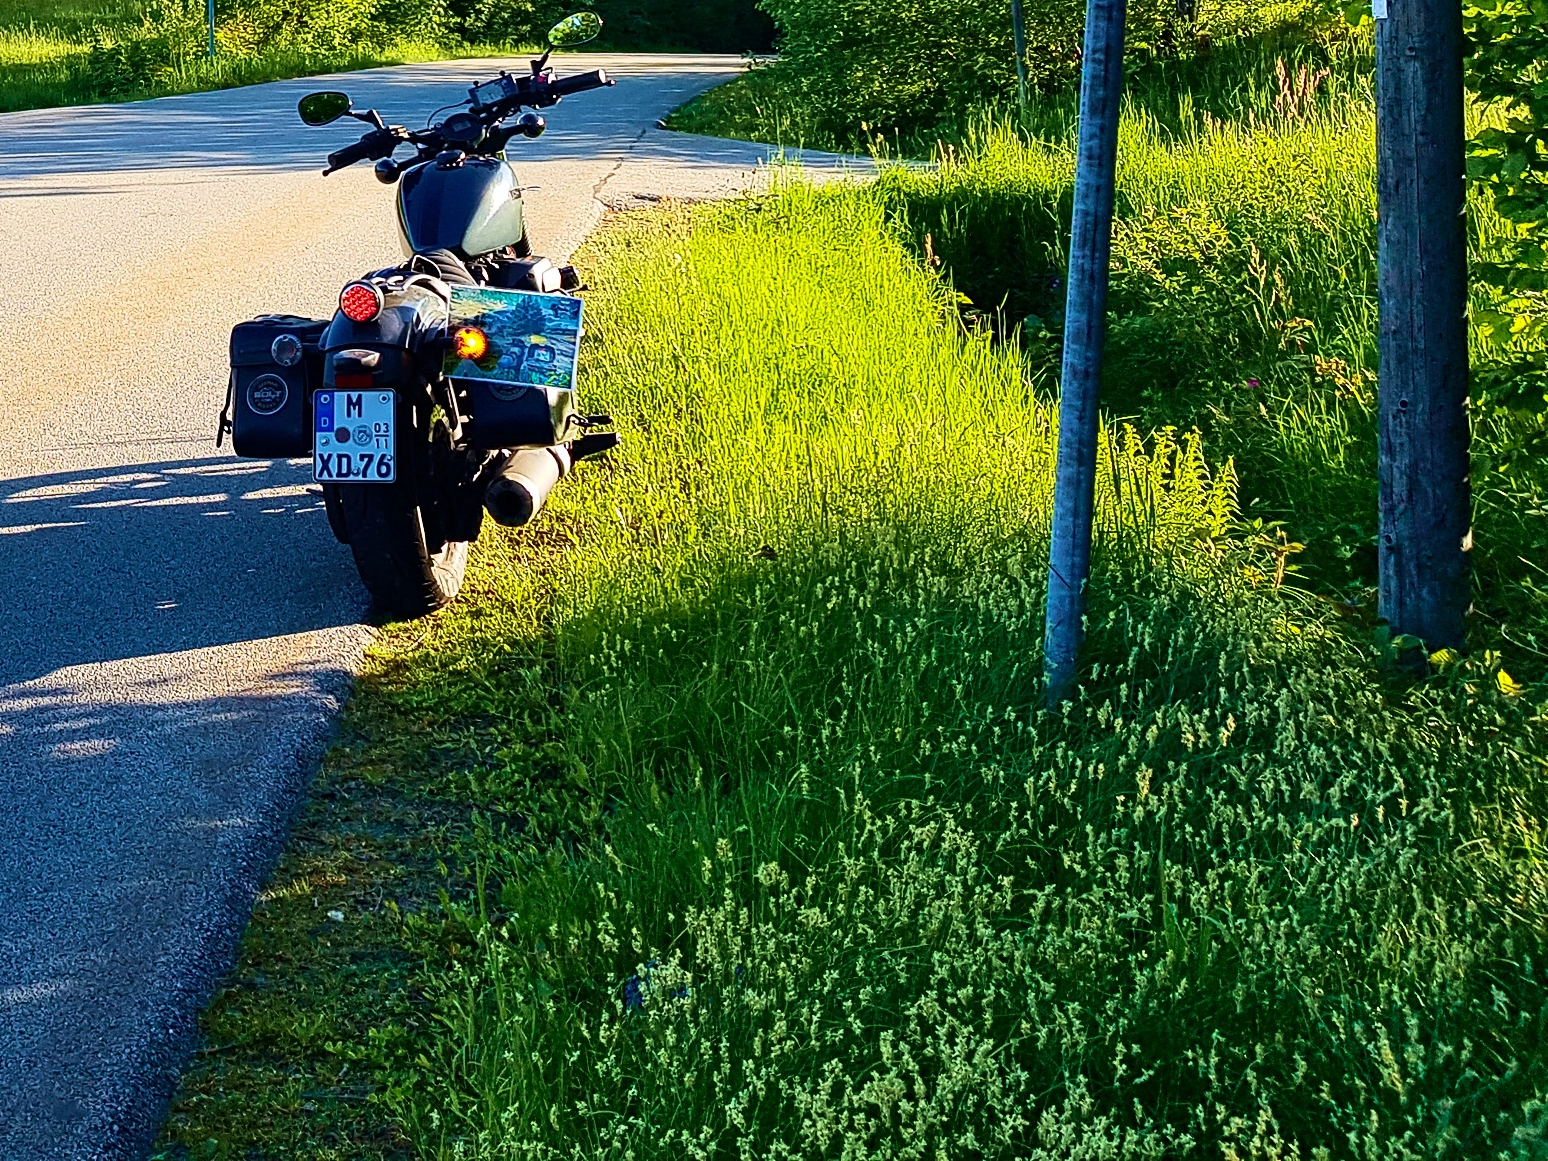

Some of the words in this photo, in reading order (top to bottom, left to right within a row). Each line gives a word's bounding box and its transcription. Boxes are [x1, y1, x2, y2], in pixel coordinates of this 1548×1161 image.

[346, 393, 363, 418] M
[321, 417, 329, 427] D
[374, 422, 389, 434] 03
[375, 438, 388, 449] 11
